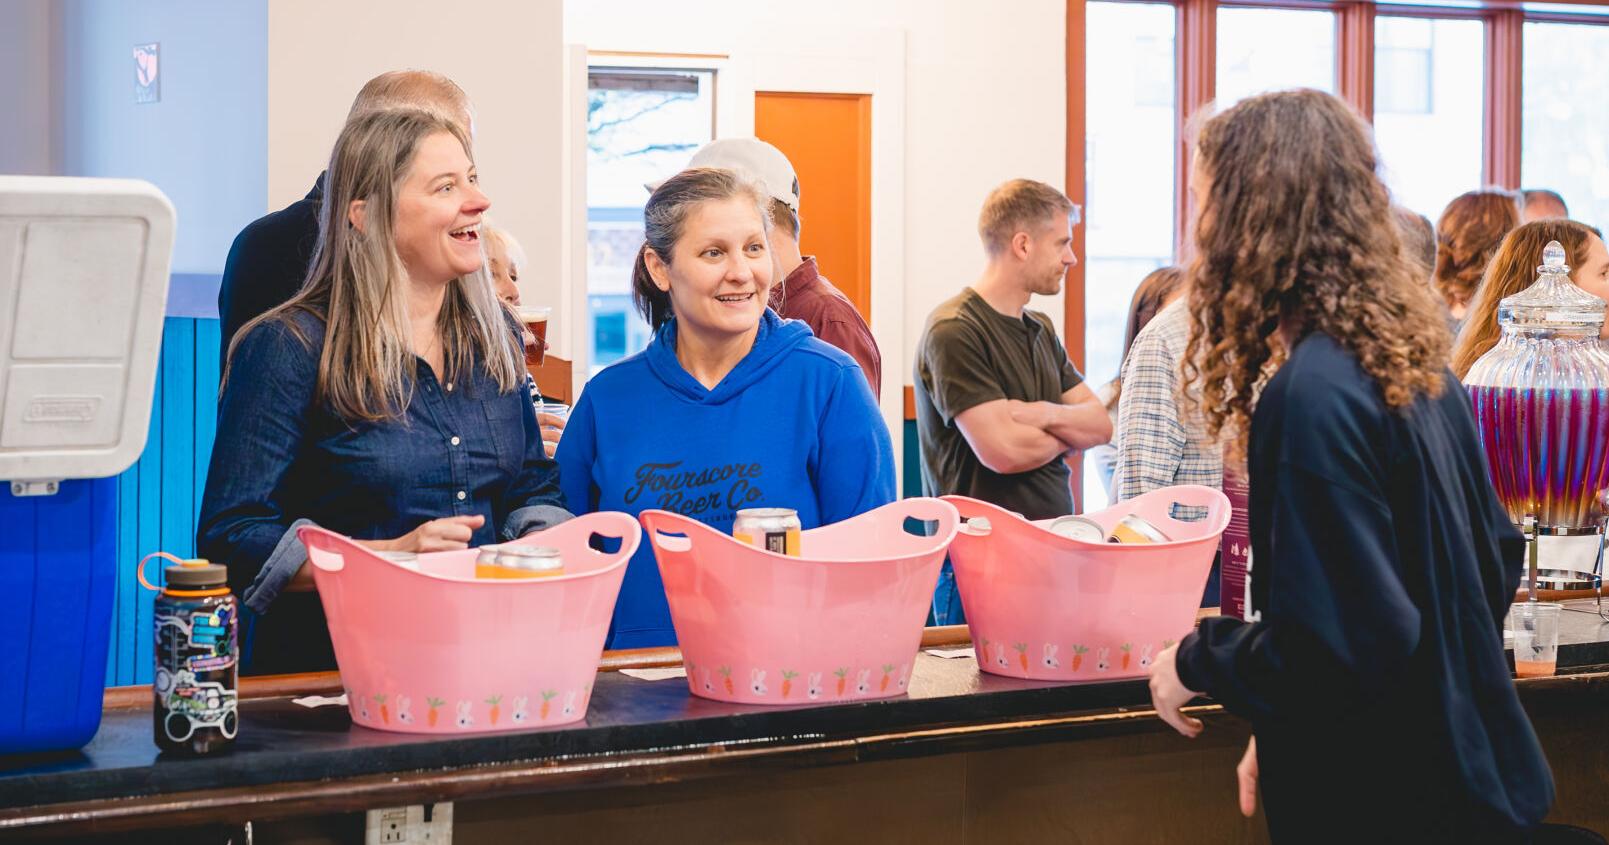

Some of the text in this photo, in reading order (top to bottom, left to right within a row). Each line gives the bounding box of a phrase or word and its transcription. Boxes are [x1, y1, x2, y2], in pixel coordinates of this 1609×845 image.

[624, 460, 763, 504] Fourscore
[656, 479, 765, 515] Beer Co.
